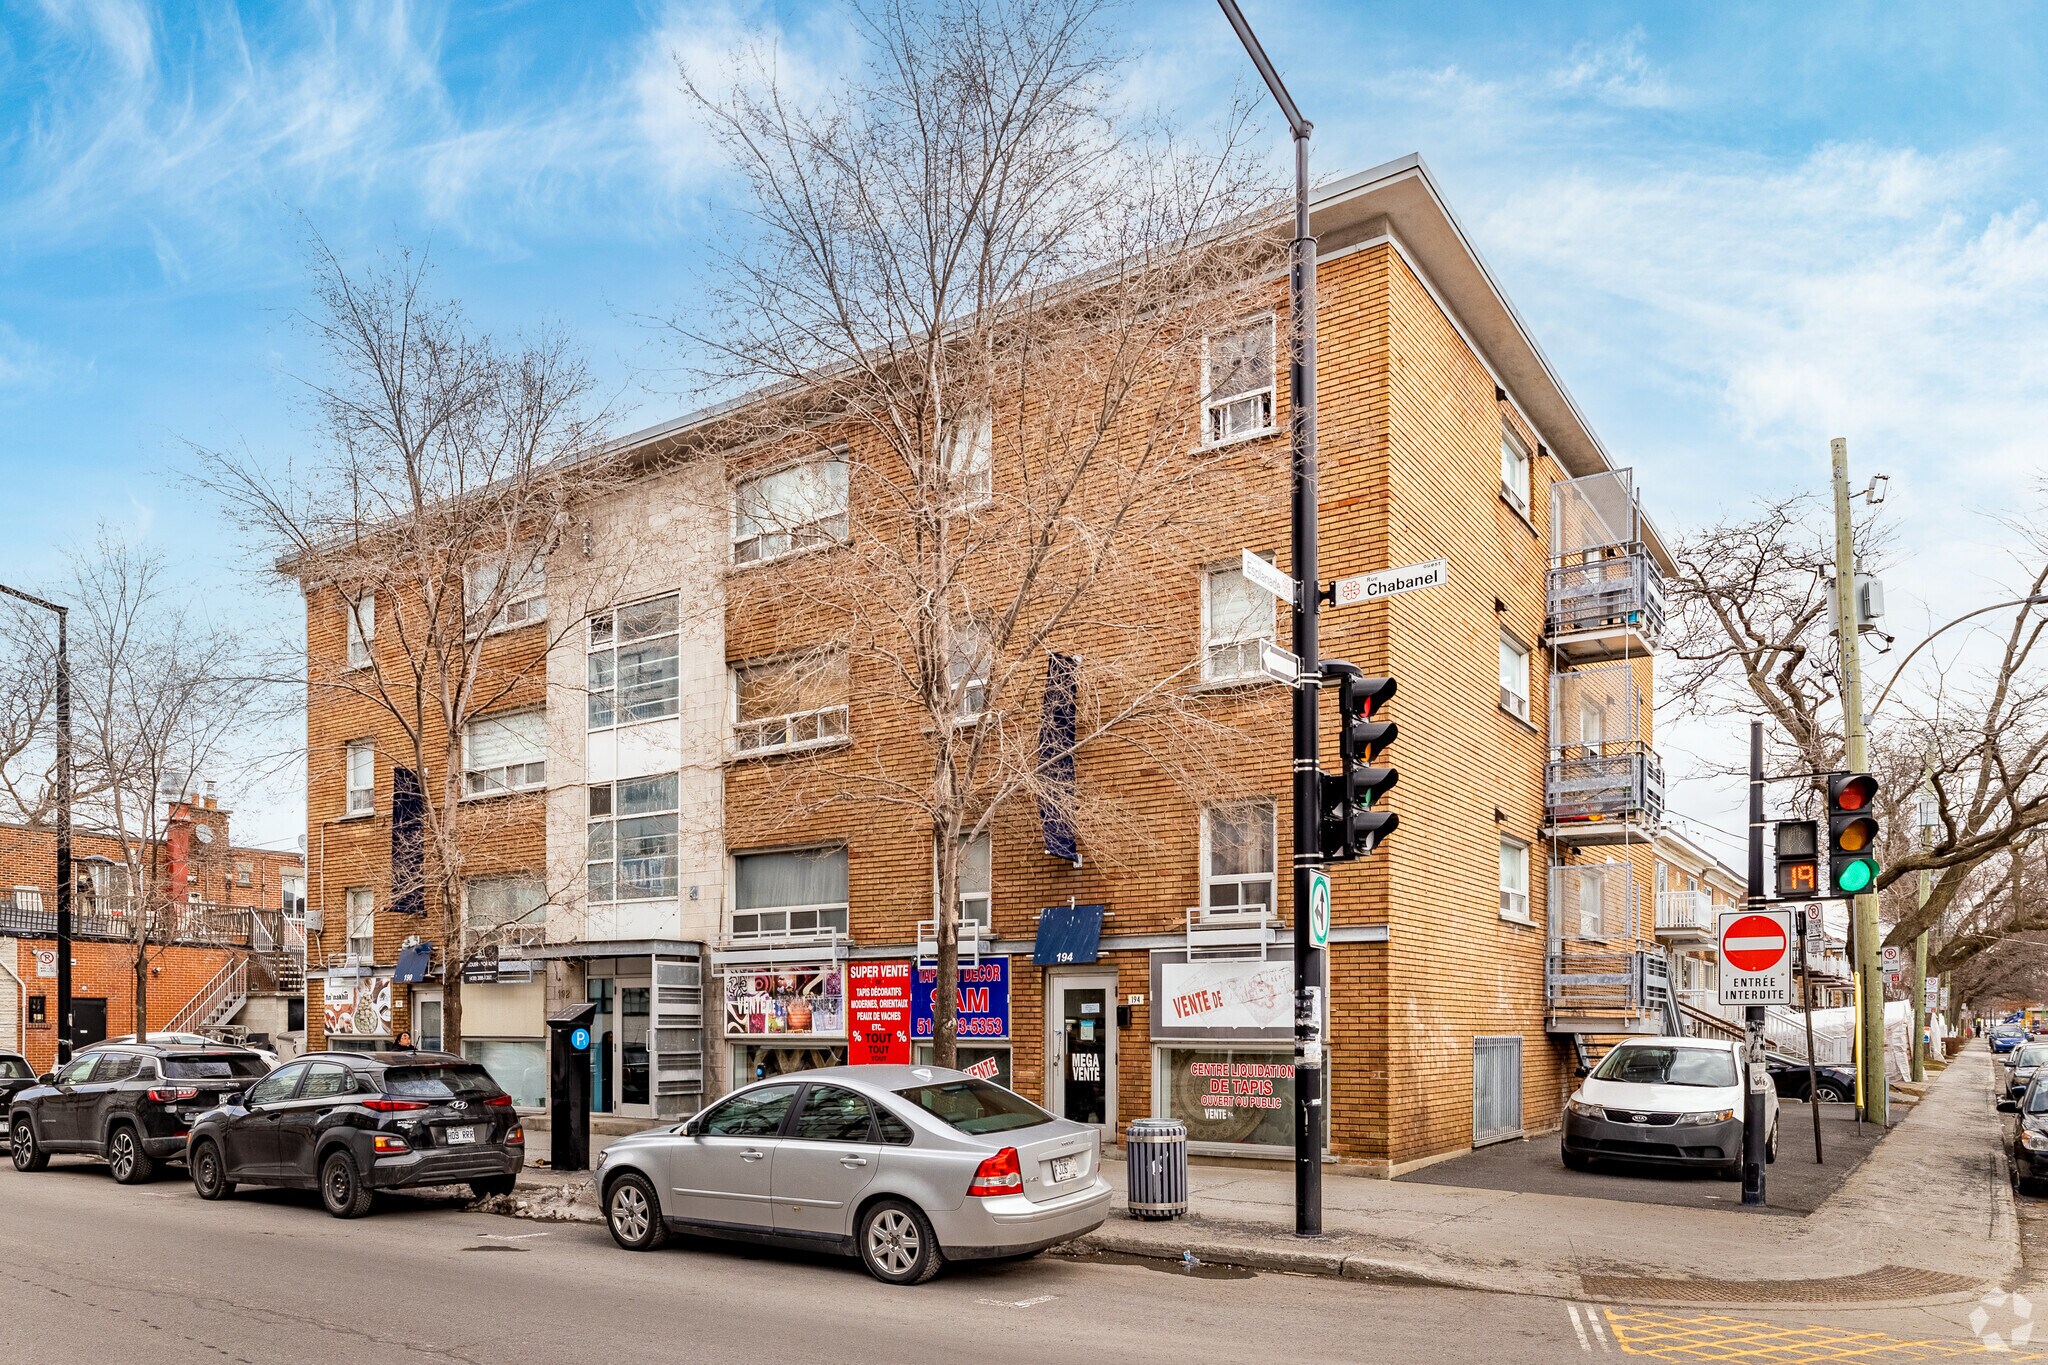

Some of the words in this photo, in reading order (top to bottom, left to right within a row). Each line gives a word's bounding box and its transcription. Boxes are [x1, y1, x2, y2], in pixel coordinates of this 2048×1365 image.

[1423, 561, 1441, 569] ouest
[1367, 570, 1438, 596] Chabanel
[1792, 865, 1814, 889] 19
[1057, 952, 1073, 962] 194
[850, 965, 879, 978] SUPER
[881, 965, 908, 977] VENTE
[1734, 975, 1776, 987] ENTRÉE
[856, 987, 870, 997] TAPIS
[871, 986, 902, 997] DÉCORATIFS
[1725, 990, 1784, 999] INTERDITE
[851, 999, 879, 1009] MODERNES,
[880, 998, 908, 1009] ORIENTAUX
[1131, 995, 1141, 1003] 194
[1173, 990, 1211, 1019] VENTE
[1212, 990, 1224, 1009] DE
[857, 1012, 872, 1020] PEAUX
[873, 1012, 880, 1020] DE
[881, 1011, 901, 1020] VACHES
[852, 1030, 862, 1042] %
[865, 1033, 892, 1043] TOUT
[896, 1030, 907, 1042] %
[869, 1045, 889, 1054] TOUT
[1072, 1053, 1099, 1067] MEGA
[1072, 1067, 1100, 1081] VENTE
[1191, 1063, 1229, 1077] CENTRE
[1231, 1063, 1295, 1079] LIQUIDATION
[1210, 1079, 1229, 1094] DE
[1232, 1079, 1273, 1095] TAPIS
[1201, 1095, 1234, 1107] OUVERT
[1250, 1097, 1281, 1109] PUBLIC
[1204, 1108, 1227, 1120] VENTE
